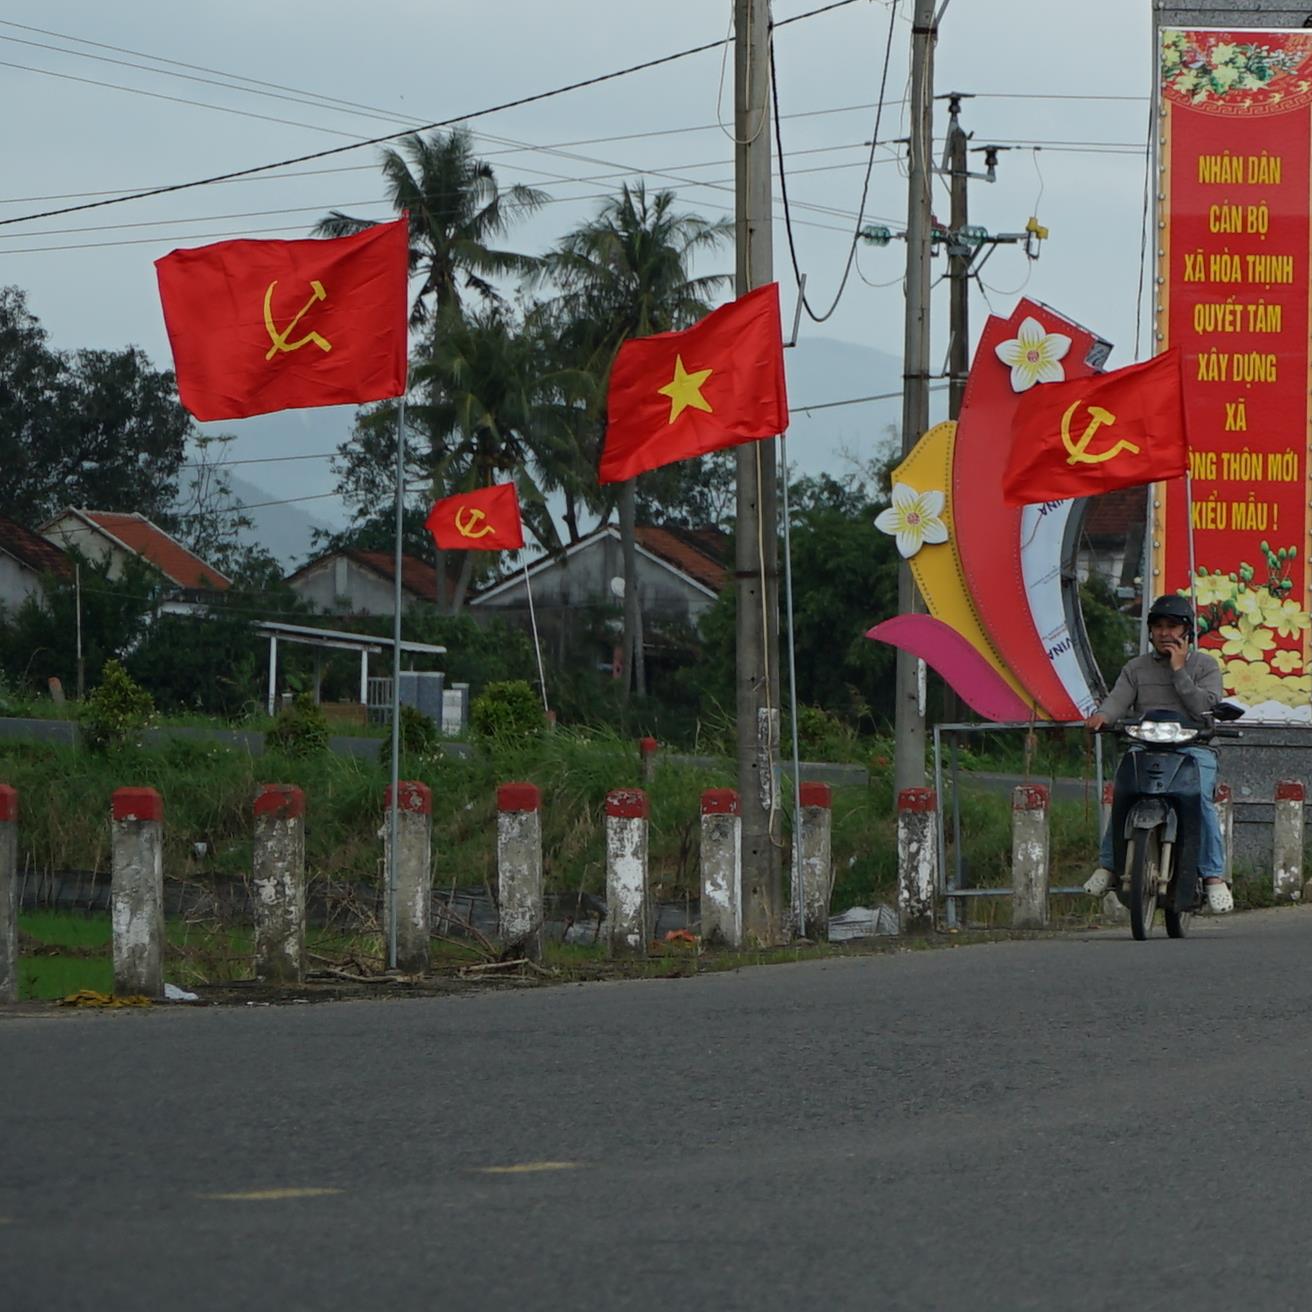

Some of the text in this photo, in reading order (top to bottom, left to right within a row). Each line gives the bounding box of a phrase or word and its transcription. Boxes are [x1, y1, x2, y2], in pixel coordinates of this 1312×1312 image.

[1198, 150, 1281, 184] NHÂN DÂN
[1209, 199, 1269, 240] CÁN BỘ
[1184, 247, 1294, 290] XÃ HÒA THỊNH
[1194, 295, 1282, 335] QUYẾT TÂM
[1197, 346, 1277, 388] XÂY DỰNG
[1224, 397, 1247, 431] XÃ
[1221, 446, 1263, 481] THÔN
[1267, 447, 1298, 481] MỚI
[1191, 490, 1227, 530] KIỂU
[1231, 491, 1268, 531] MẪU
